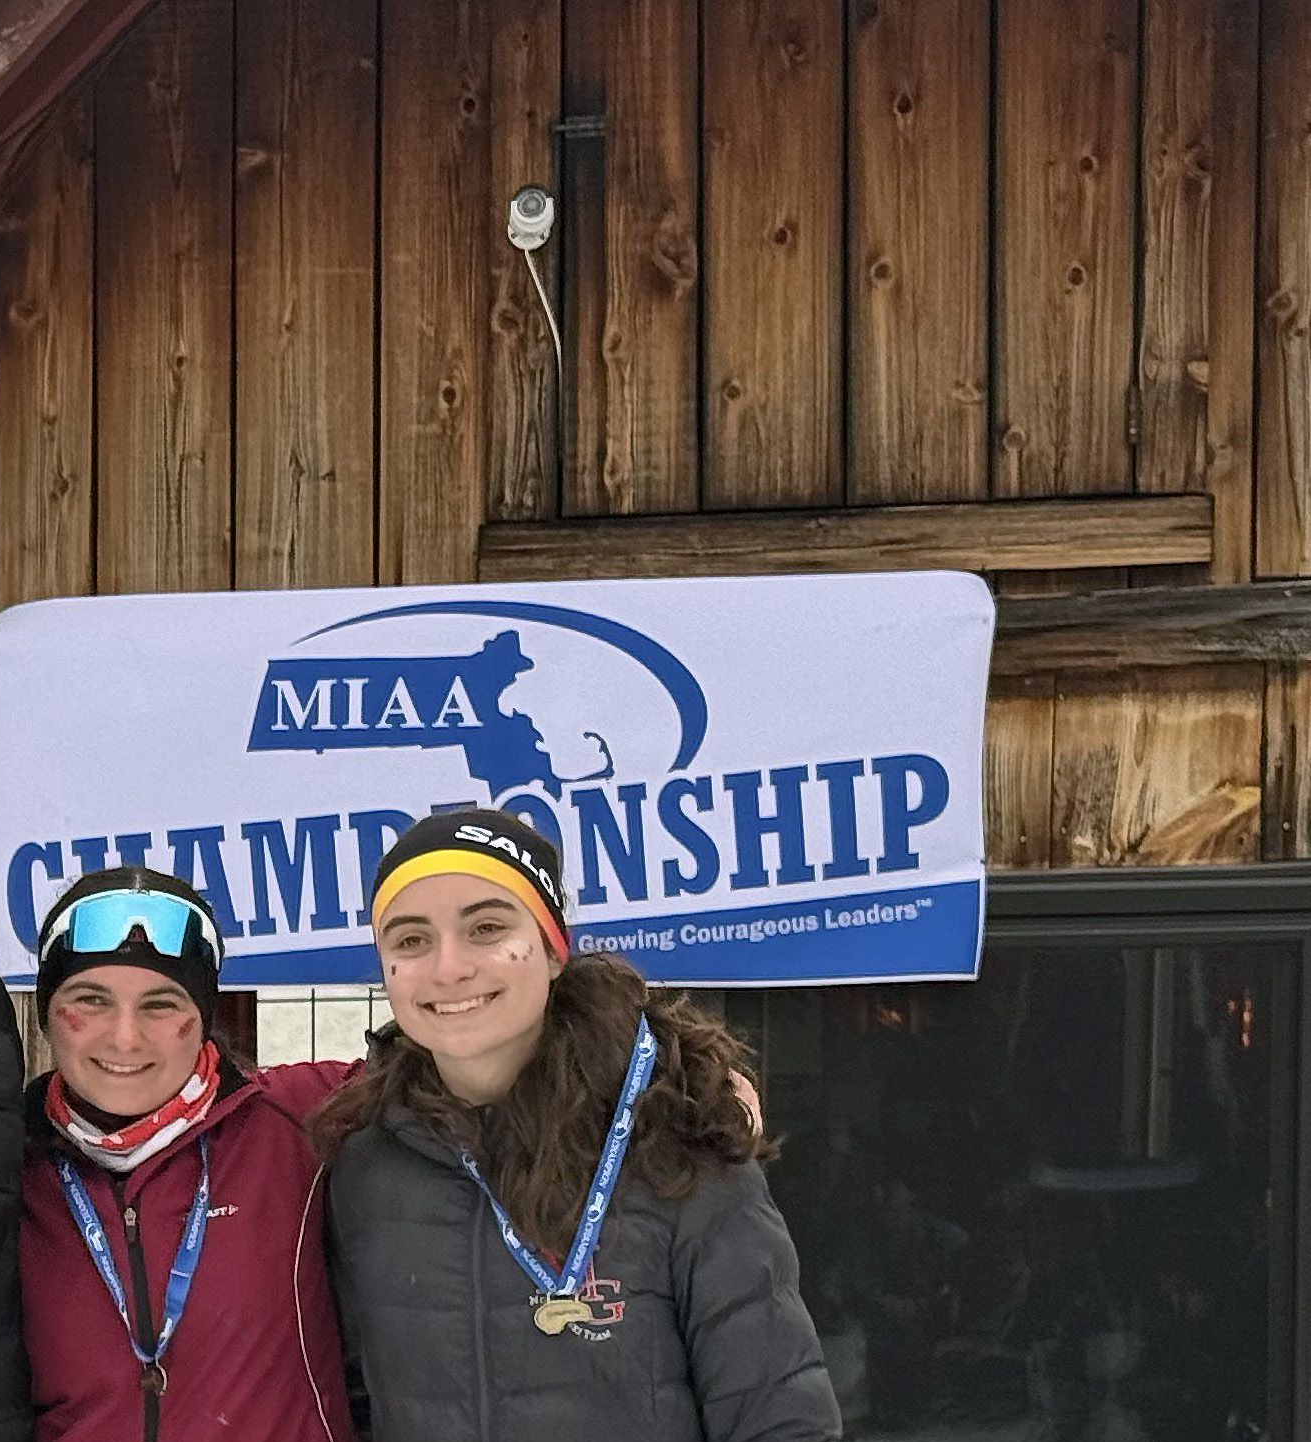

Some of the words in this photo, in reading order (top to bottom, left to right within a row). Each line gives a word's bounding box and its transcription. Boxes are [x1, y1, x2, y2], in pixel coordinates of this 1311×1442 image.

[270, 675, 484, 731] MIAA
[6, 753, 951, 957] CAMPONSHIP
[454, 825, 561, 908] SALO
[578, 927, 676, 952] Growing
[680, 914, 818, 945] Courageous
